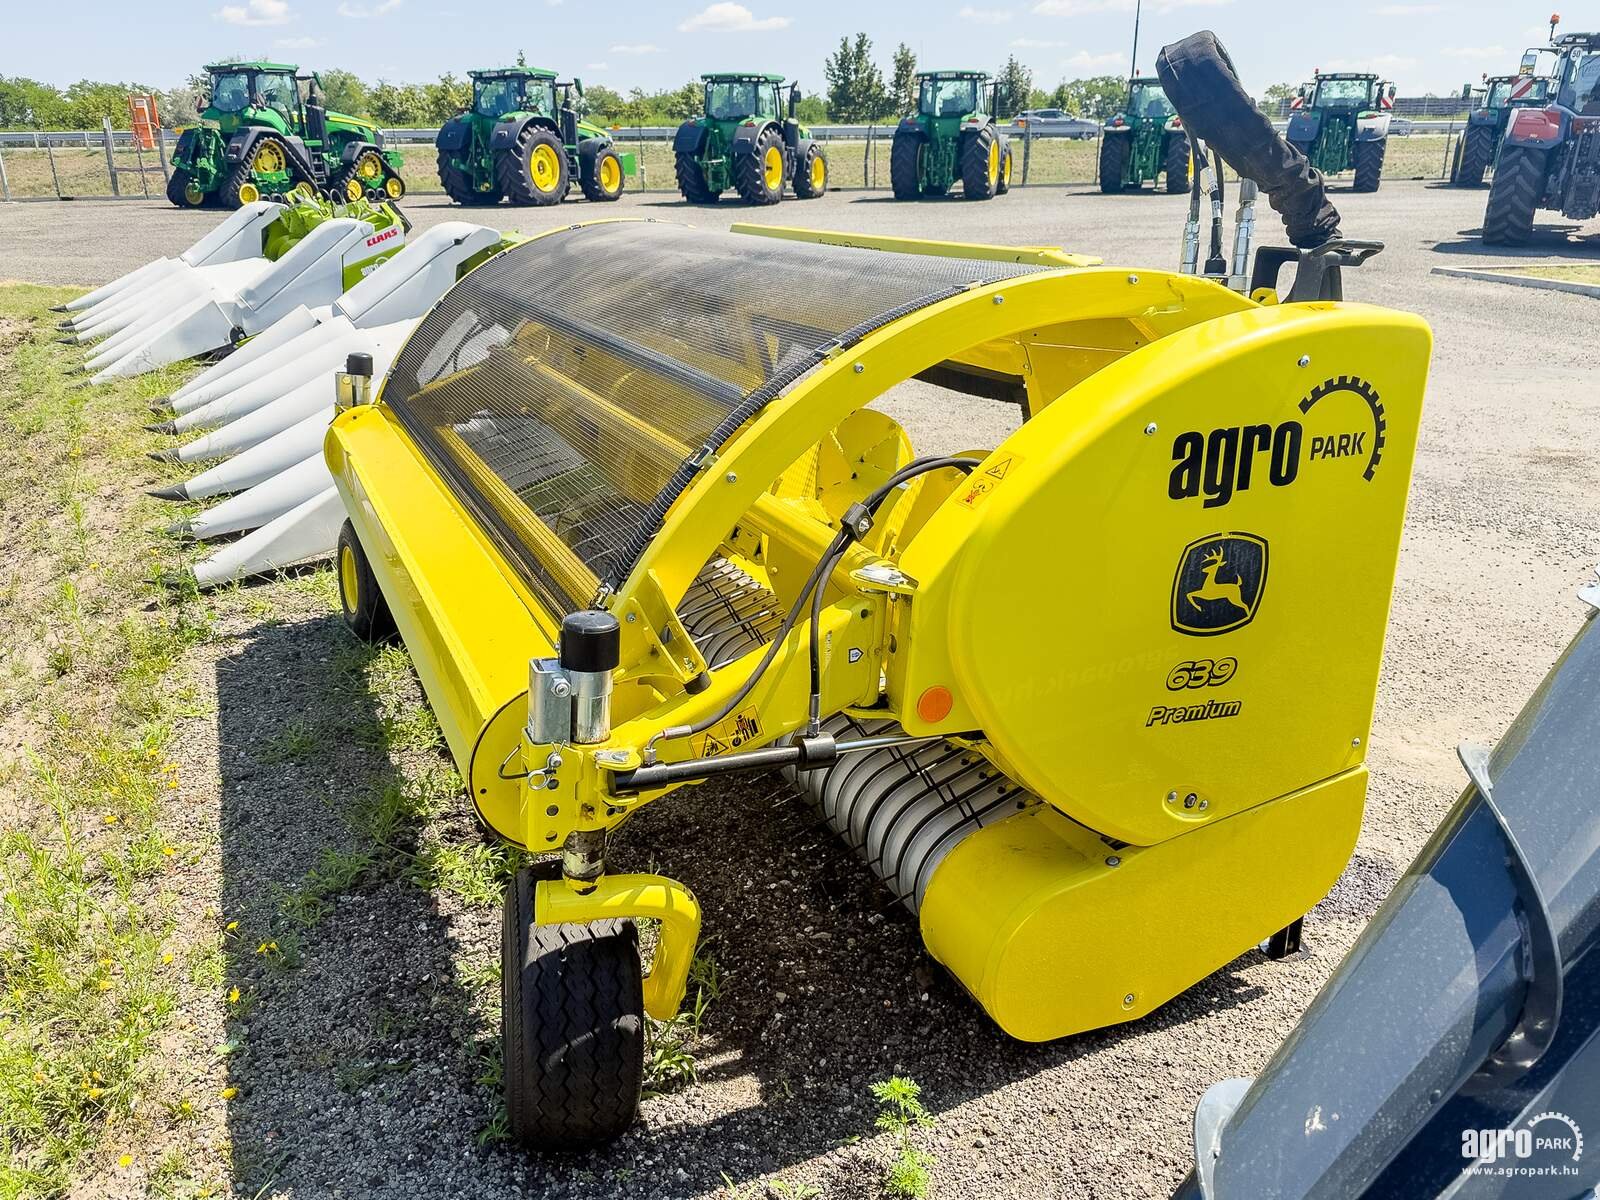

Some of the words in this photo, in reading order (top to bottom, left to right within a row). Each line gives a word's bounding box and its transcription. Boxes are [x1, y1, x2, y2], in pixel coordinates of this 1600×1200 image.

[367, 229, 397, 246] CLAAS
[1168, 421, 1303, 509] agro
[1310, 432, 1366, 461] PARK
[1166, 657, 1238, 691] 639
[1145, 700, 1242, 727] Premium
